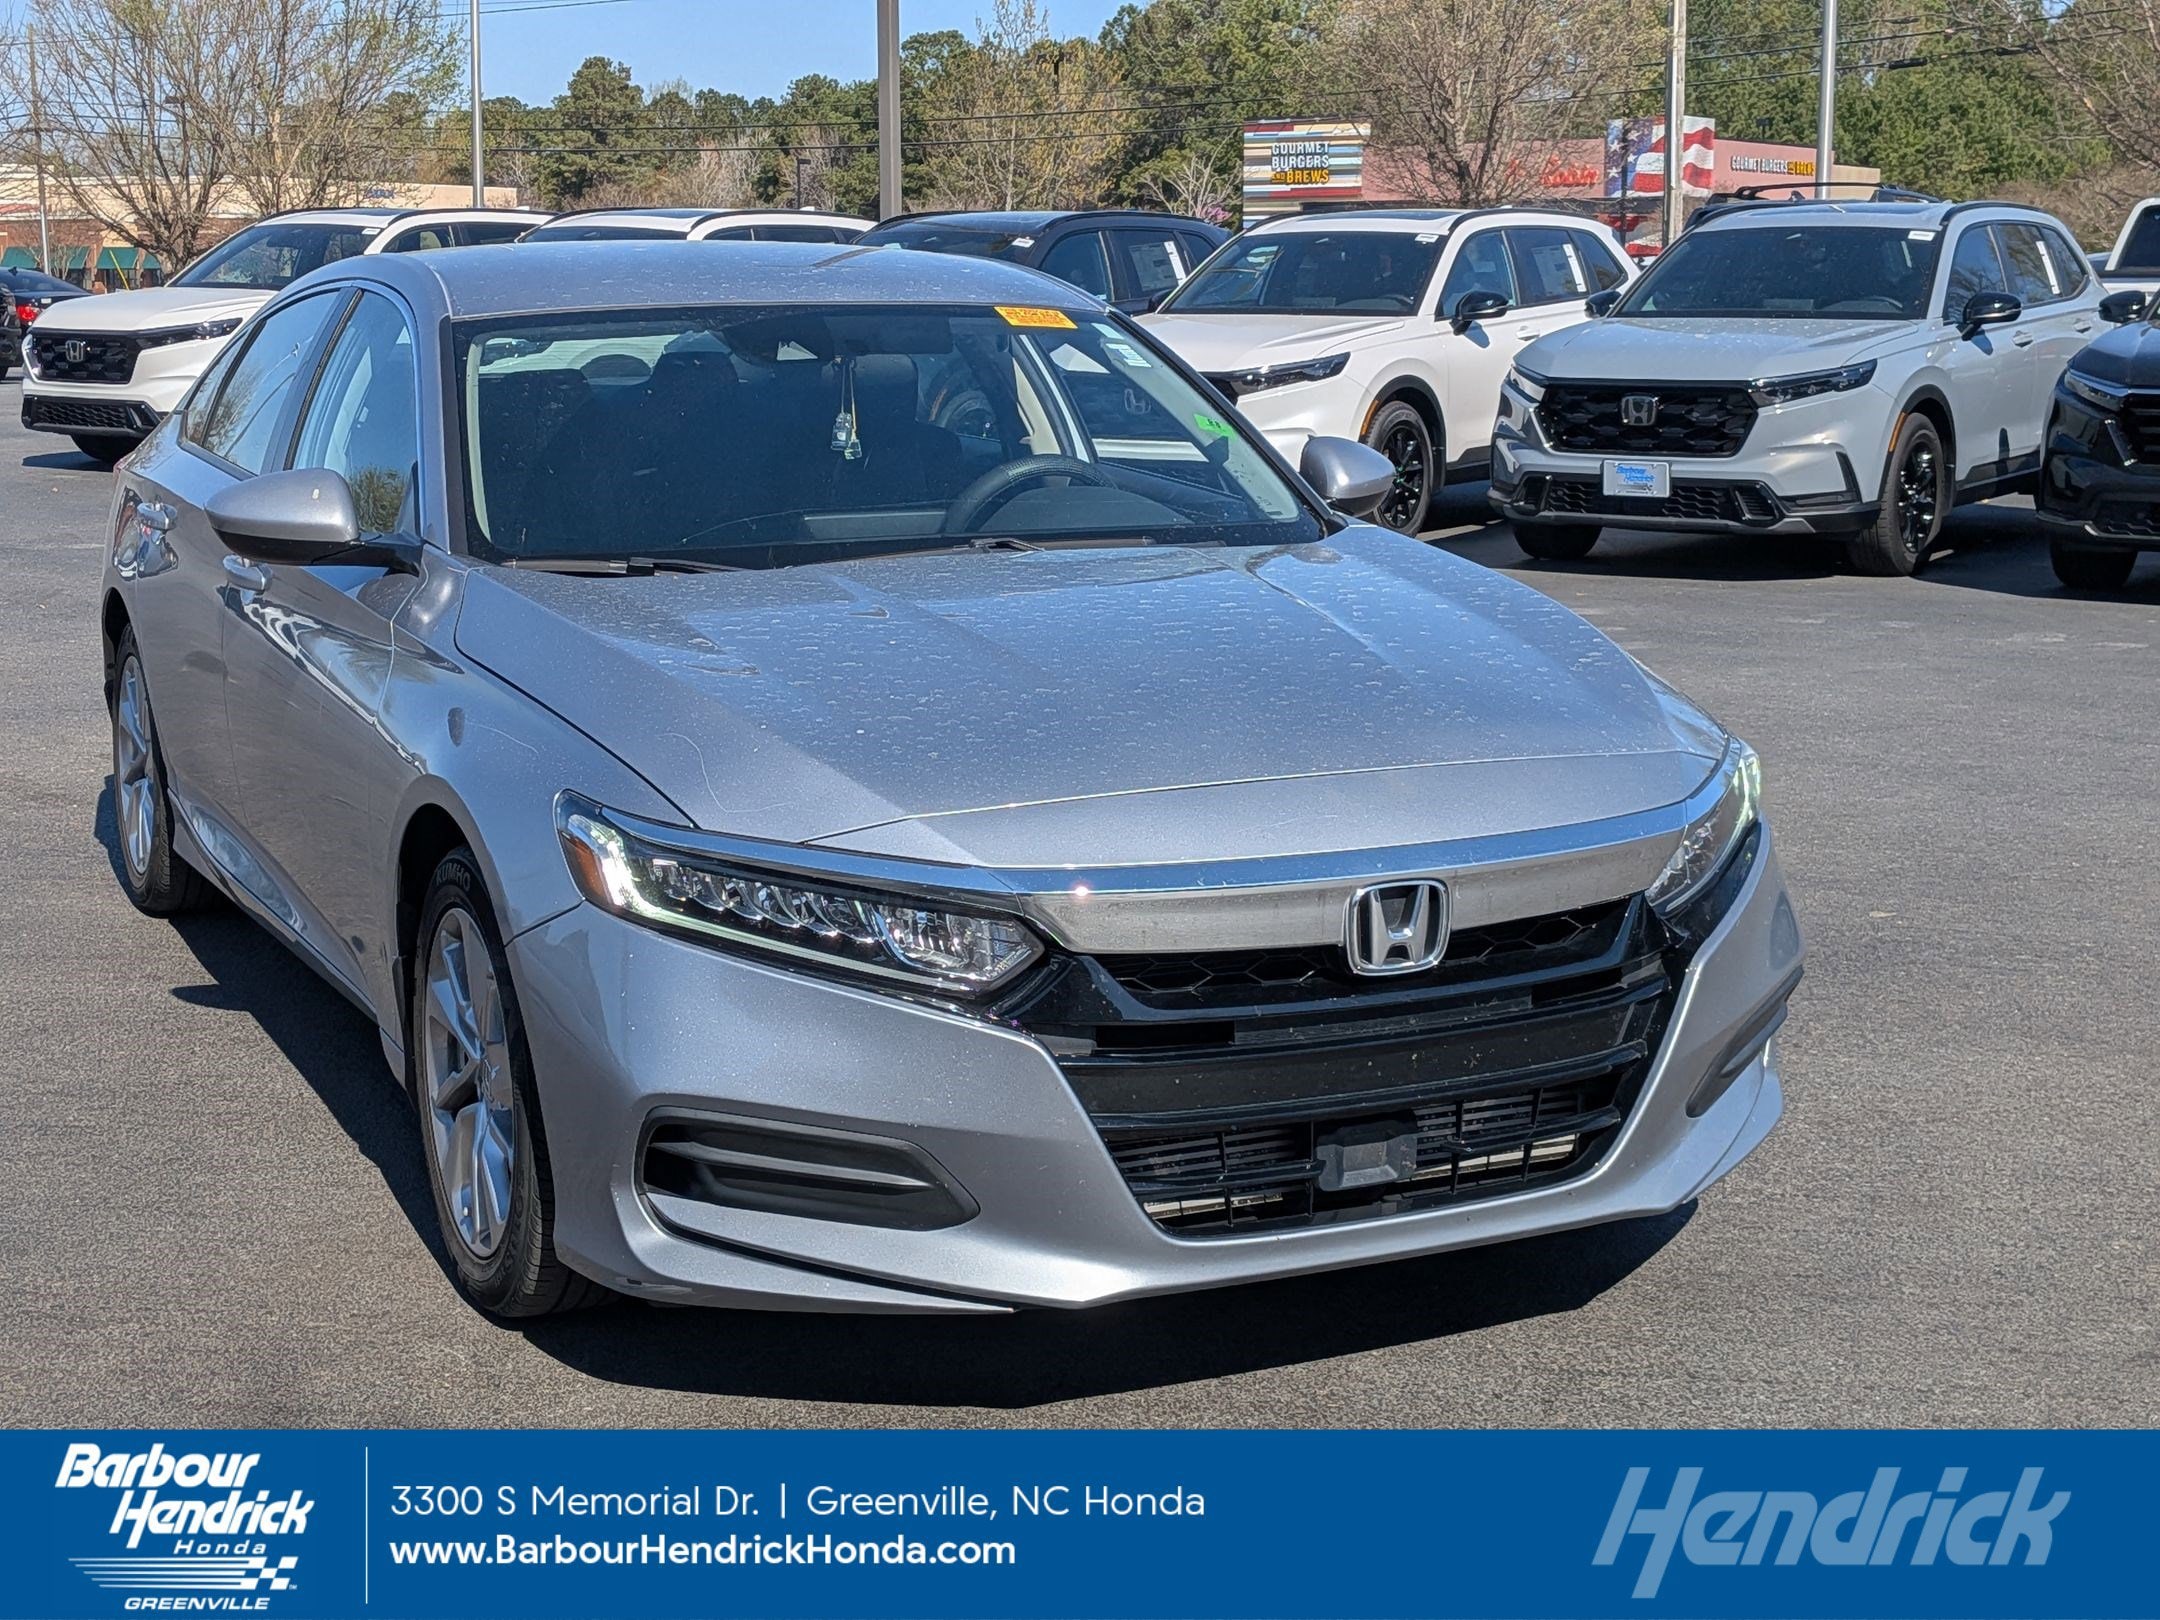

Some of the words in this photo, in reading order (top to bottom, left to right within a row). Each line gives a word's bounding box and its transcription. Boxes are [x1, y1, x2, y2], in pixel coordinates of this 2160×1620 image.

[1272, 142, 1328, 154] GOURMET
[1272, 155, 1328, 168] BURGERS
[1732, 155, 1760, 171] GOURMET
[1286, 170, 1328, 182] BREWS
[436, 862, 471, 892] KUMHO
